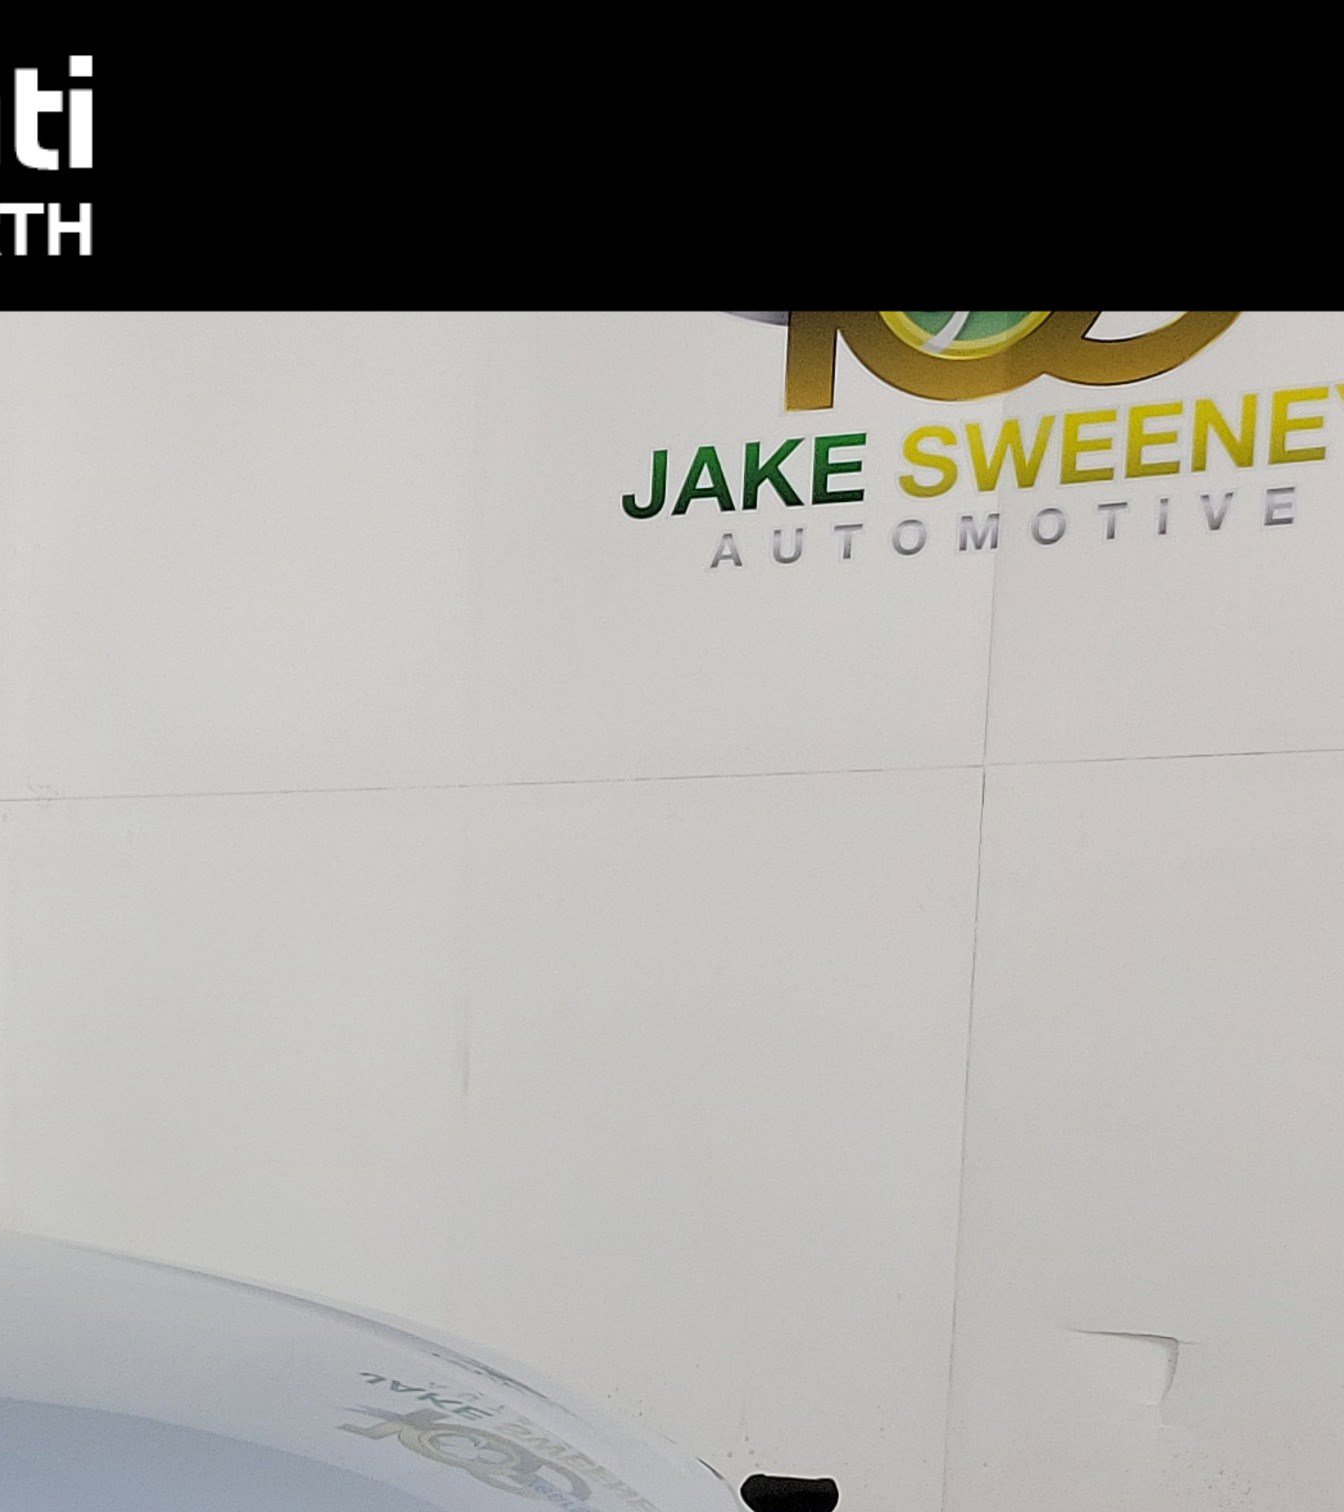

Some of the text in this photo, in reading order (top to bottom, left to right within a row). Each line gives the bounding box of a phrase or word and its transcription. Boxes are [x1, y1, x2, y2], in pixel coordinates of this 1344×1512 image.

[621, 384, 1344, 520] JAKE SWEENE
[710, 486, 1296, 569] AUTOMOTIVE
